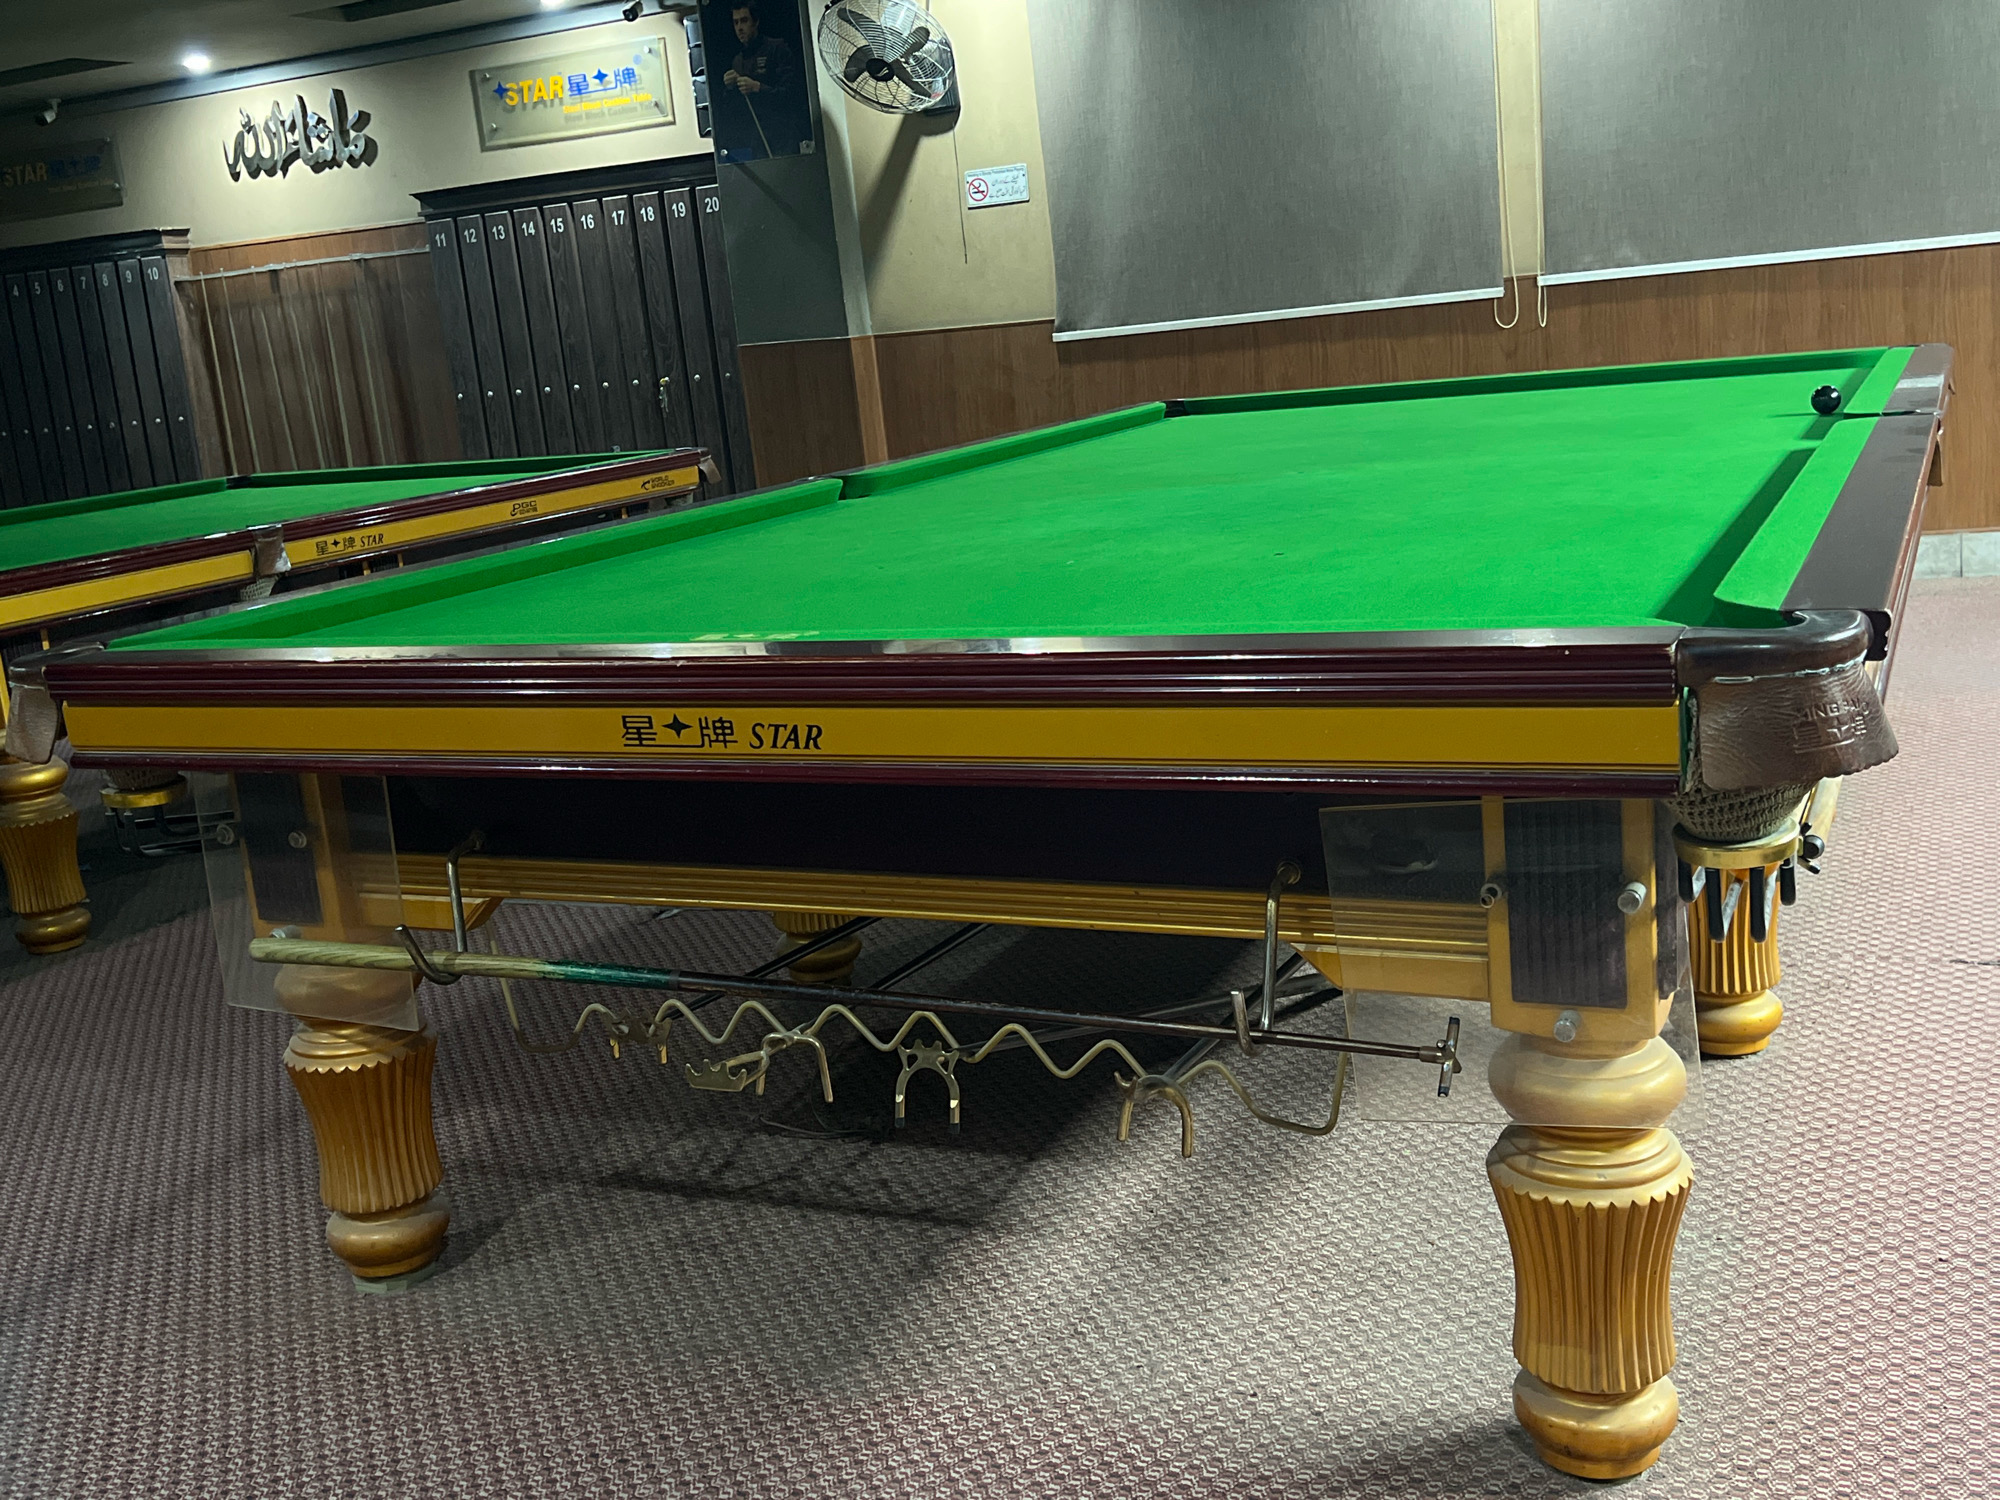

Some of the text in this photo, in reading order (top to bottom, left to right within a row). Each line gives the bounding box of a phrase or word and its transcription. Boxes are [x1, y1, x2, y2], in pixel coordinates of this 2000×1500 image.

[505, 75, 564, 106] STAR
[3, 160, 48, 188] STAR
[671, 202, 686, 218] 19
[705, 197, 720, 213] 20
[581, 213, 595, 229] 16
[611, 210, 625, 225] 17
[640, 206, 655, 222] 18
[492, 225, 506, 240] 13
[521, 221, 536, 236] 14
[550, 218, 565, 233] 15
[435, 232, 447, 247] 11
[464, 228, 477, 243] 12
[102, 274, 109, 287] 8
[125, 270, 133, 283] 9
[148, 267, 159, 281] 10
[13, 284, 19, 297] 4
[34, 282, 41, 295] 5
[57, 279, 64, 292] 6
[80, 277, 87, 289] 7
[360, 533, 384, 547] STAR
[621, 713, 823, 750] 星牌 STAR
